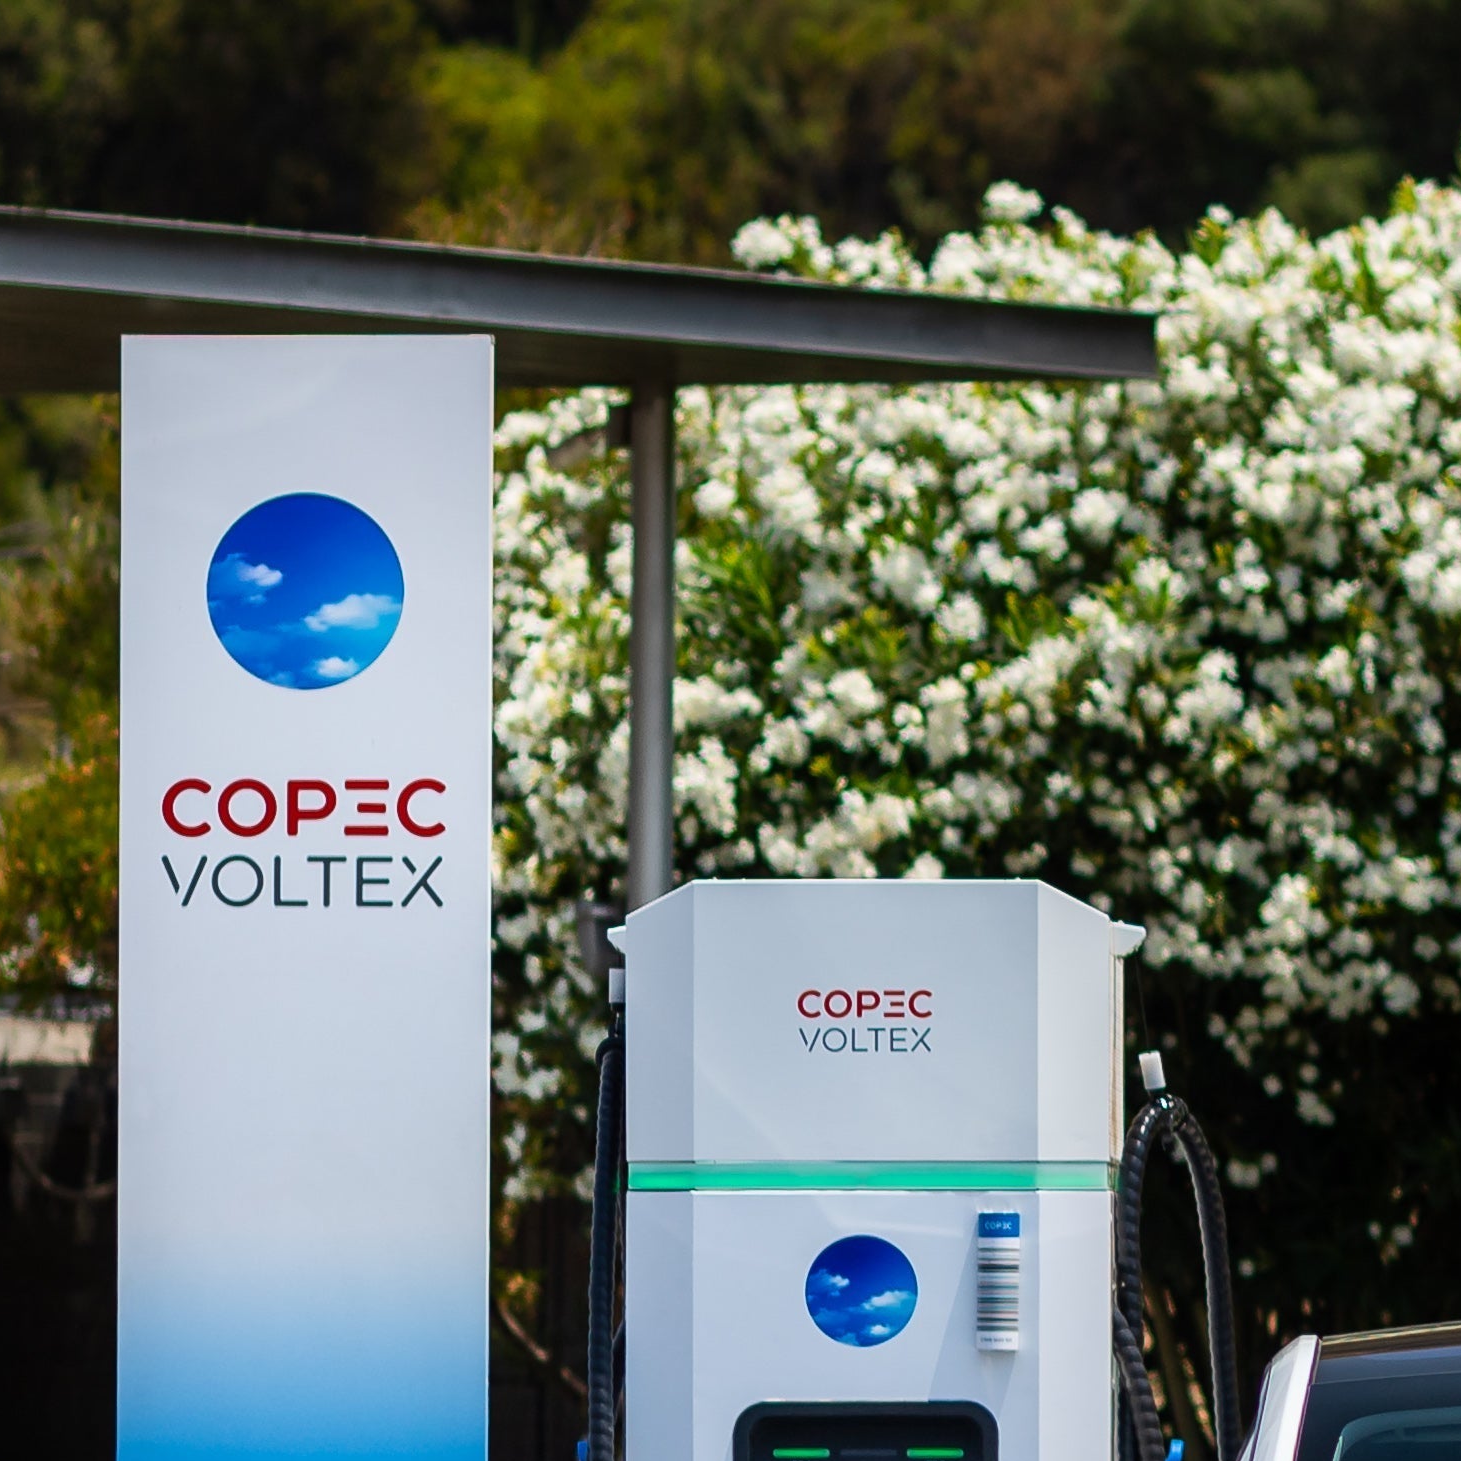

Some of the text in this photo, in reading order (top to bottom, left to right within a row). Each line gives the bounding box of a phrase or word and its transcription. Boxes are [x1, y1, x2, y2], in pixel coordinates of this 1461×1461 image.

[161, 778, 447, 838] COPEC
[161, 854, 445, 908] VOLTEX
[797, 989, 933, 1019] COPEC
[798, 1027, 932, 1052] VOLTEX
